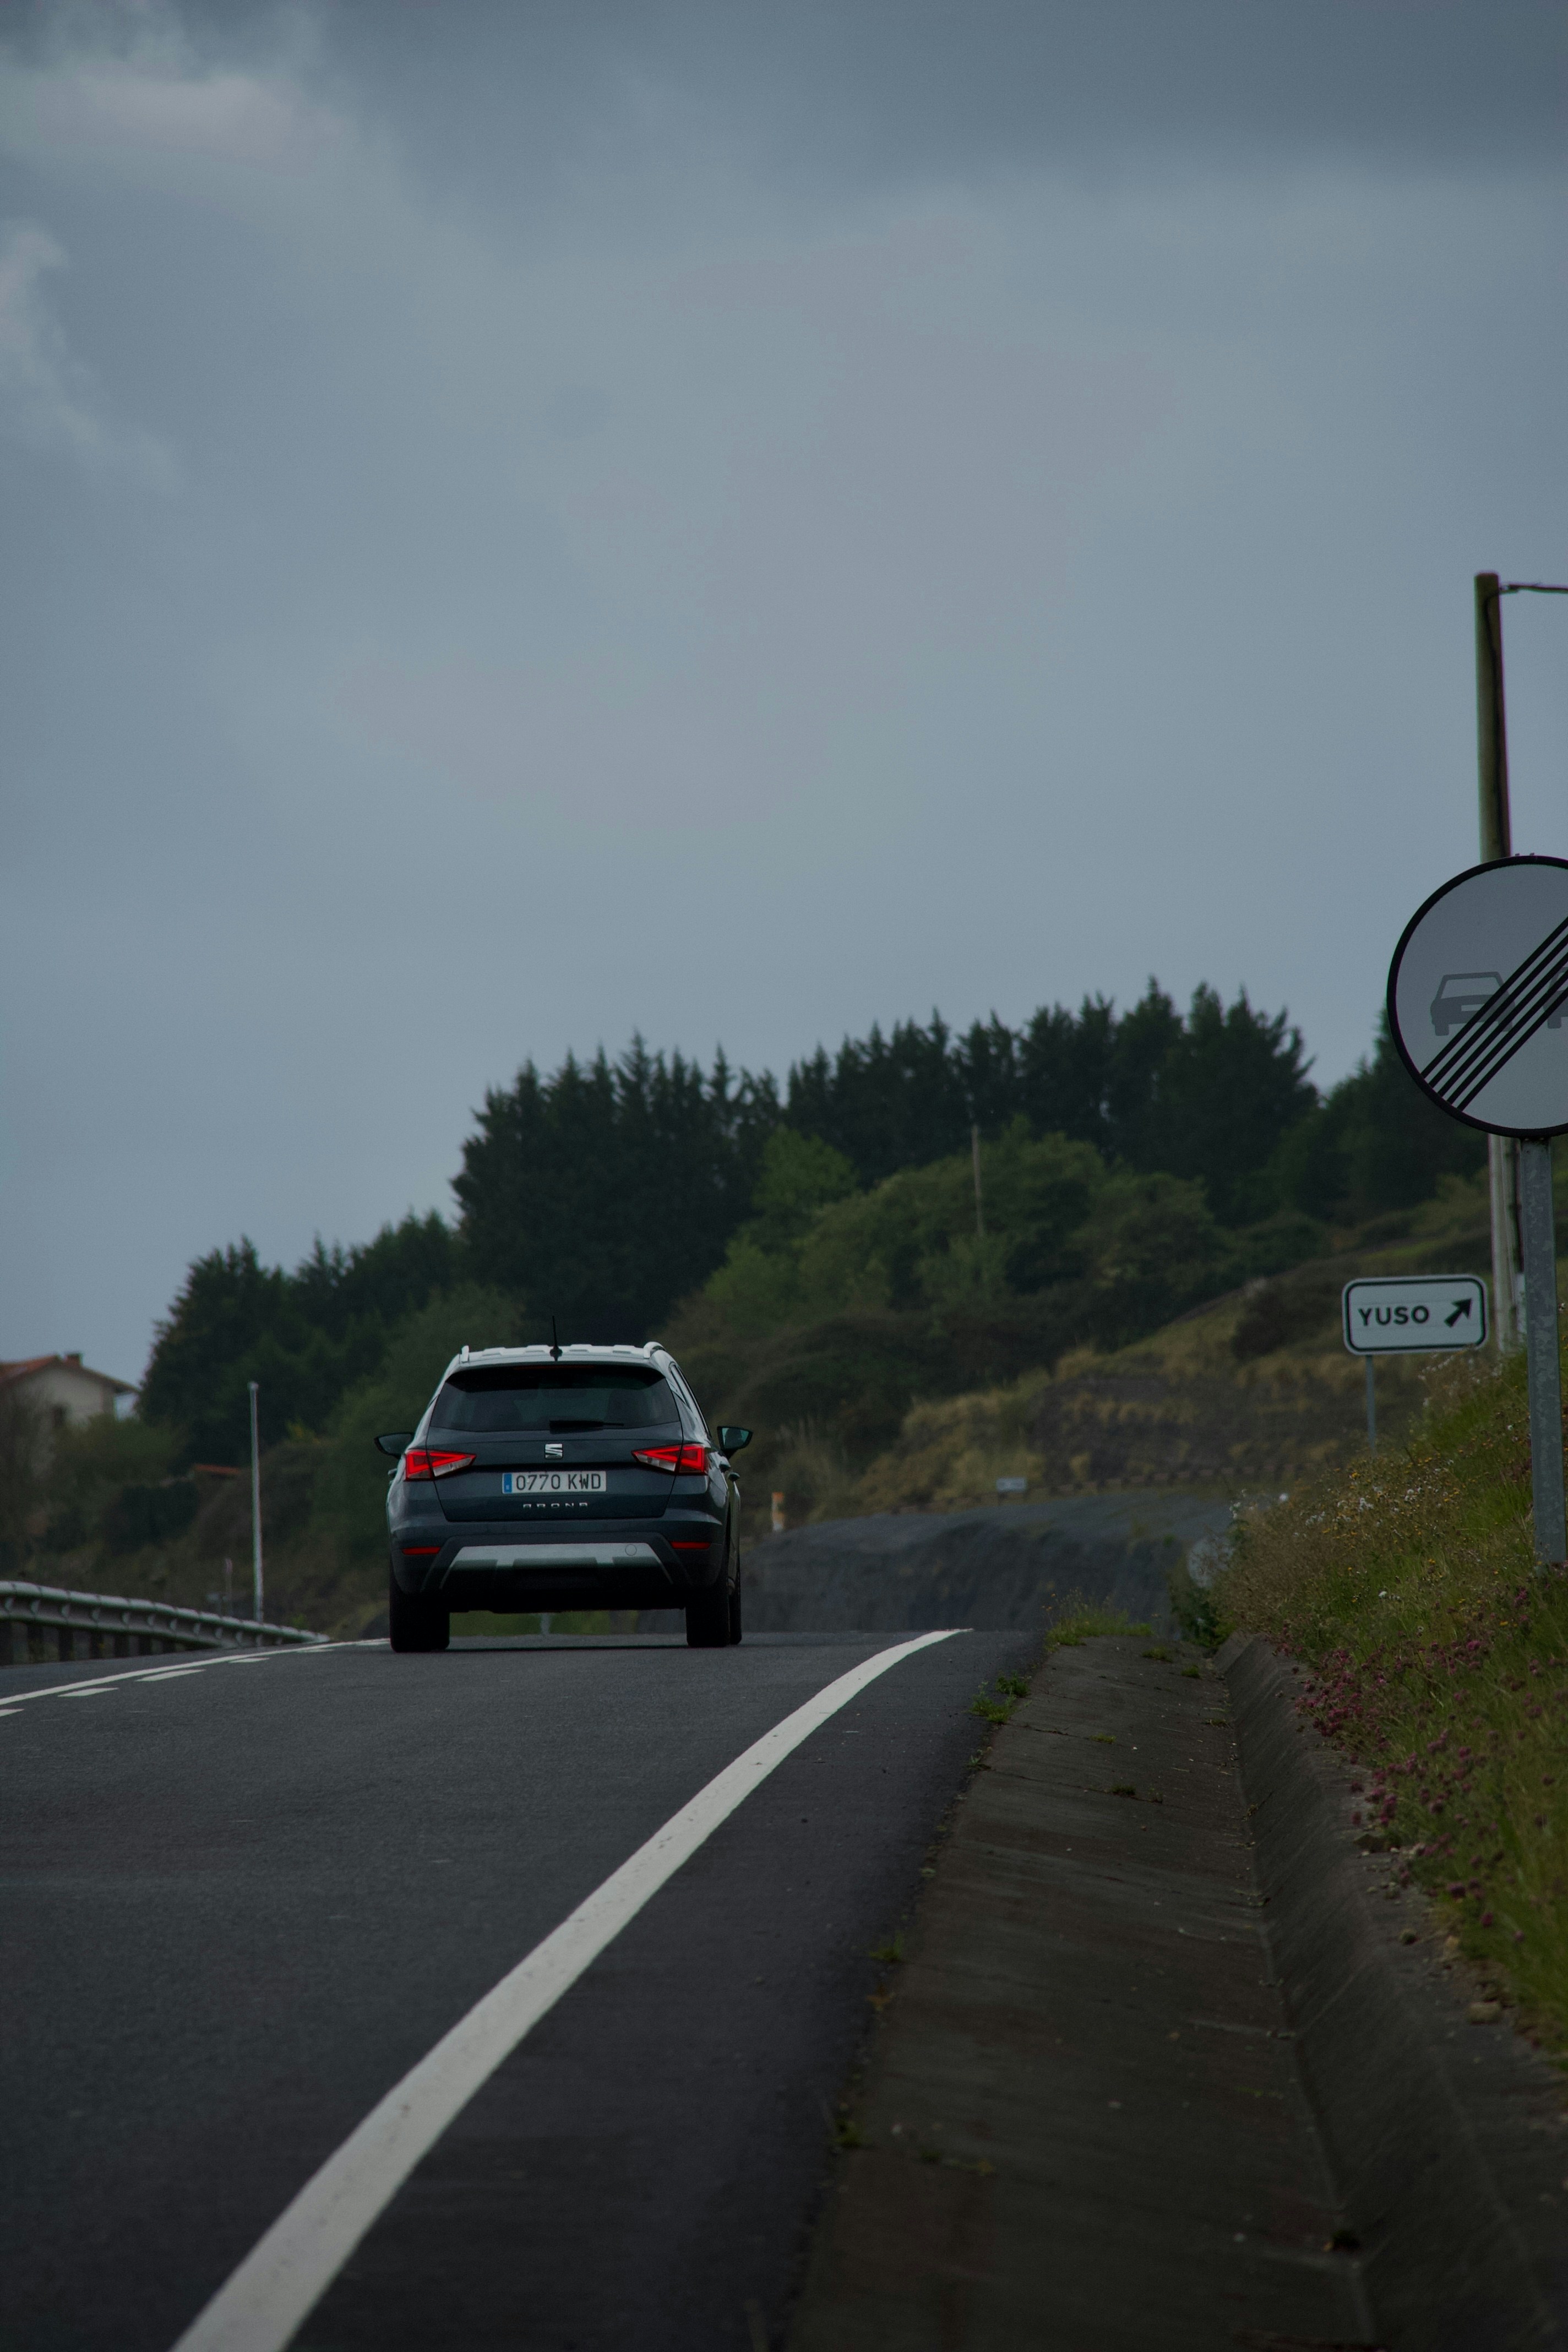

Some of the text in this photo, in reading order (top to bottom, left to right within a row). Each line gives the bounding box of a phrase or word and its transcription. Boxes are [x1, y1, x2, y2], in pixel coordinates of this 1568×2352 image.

[1358, 1306, 1429, 1326] YUSO
[516, 1474, 560, 1490] 0770
[568, 1474, 601, 1489] KWD
